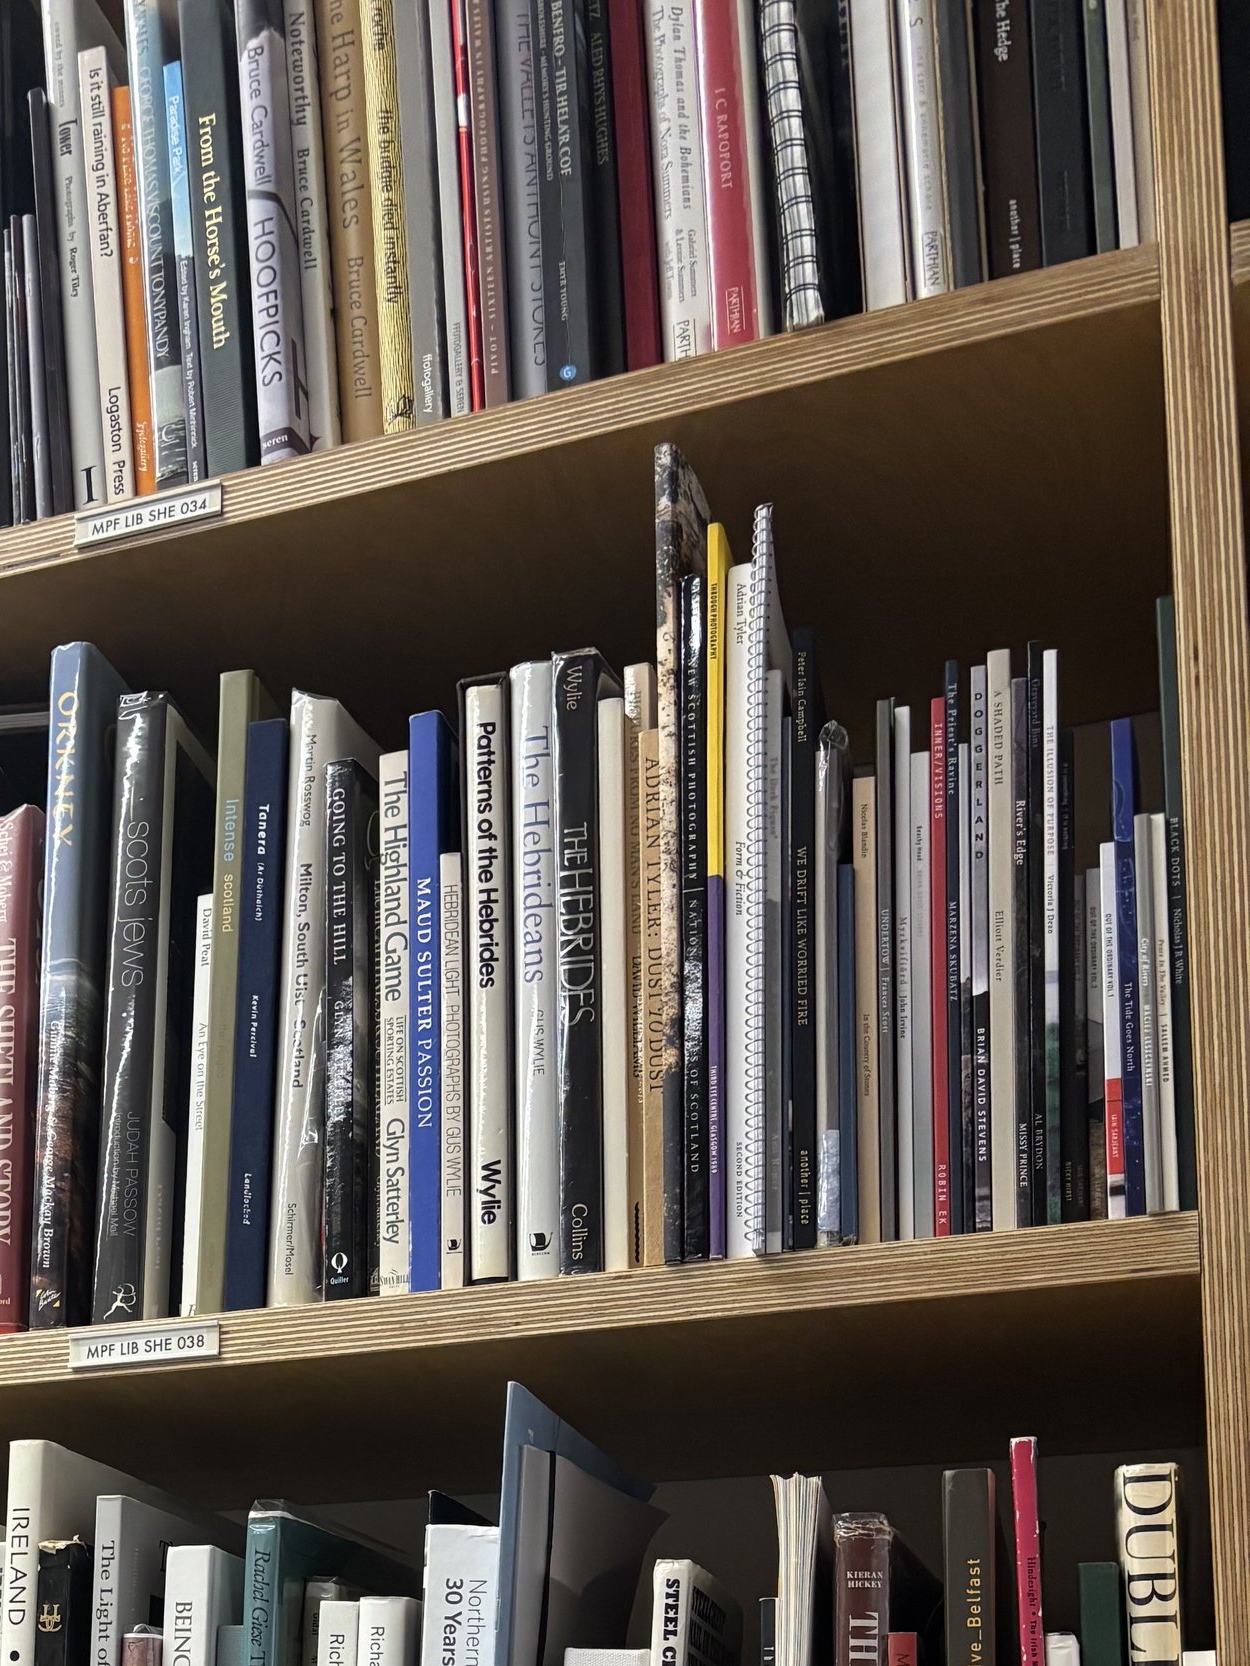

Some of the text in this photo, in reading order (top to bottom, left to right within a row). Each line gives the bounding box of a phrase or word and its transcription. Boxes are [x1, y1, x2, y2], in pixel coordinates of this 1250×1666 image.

[89, 67, 126, 496] Is it still raining in Aberfan? Logaston Press
[197, 113, 230, 349] From the Horse's Mouth
[247, 46, 283, 387] Bruce Cardwell HOOFPICKS
[421, 353, 435, 413] ffotogallery
[92, 498, 207, 536] MPF LIB SHE 034
[933, 722, 943, 819] INNER/VISIONS
[120, 821, 153, 987] scots jews
[476, 722, 502, 1225] Patterns of the Hebrides Wylie
[380, 771, 407, 1244] The Highland Game Glyn Satterley
[416, 878, 433, 1127] MAUD SULTER PASSION
[1012, 800, 1028, 1188] River's Edge MISSY PRINCE
[87, 1334, 205, 1360] MPF LIB SHE 038
[439, 1611, 462, 1665] Years
[442, 1578, 462, 1605] 30
[660, 1578, 681, 1639] STEEL
